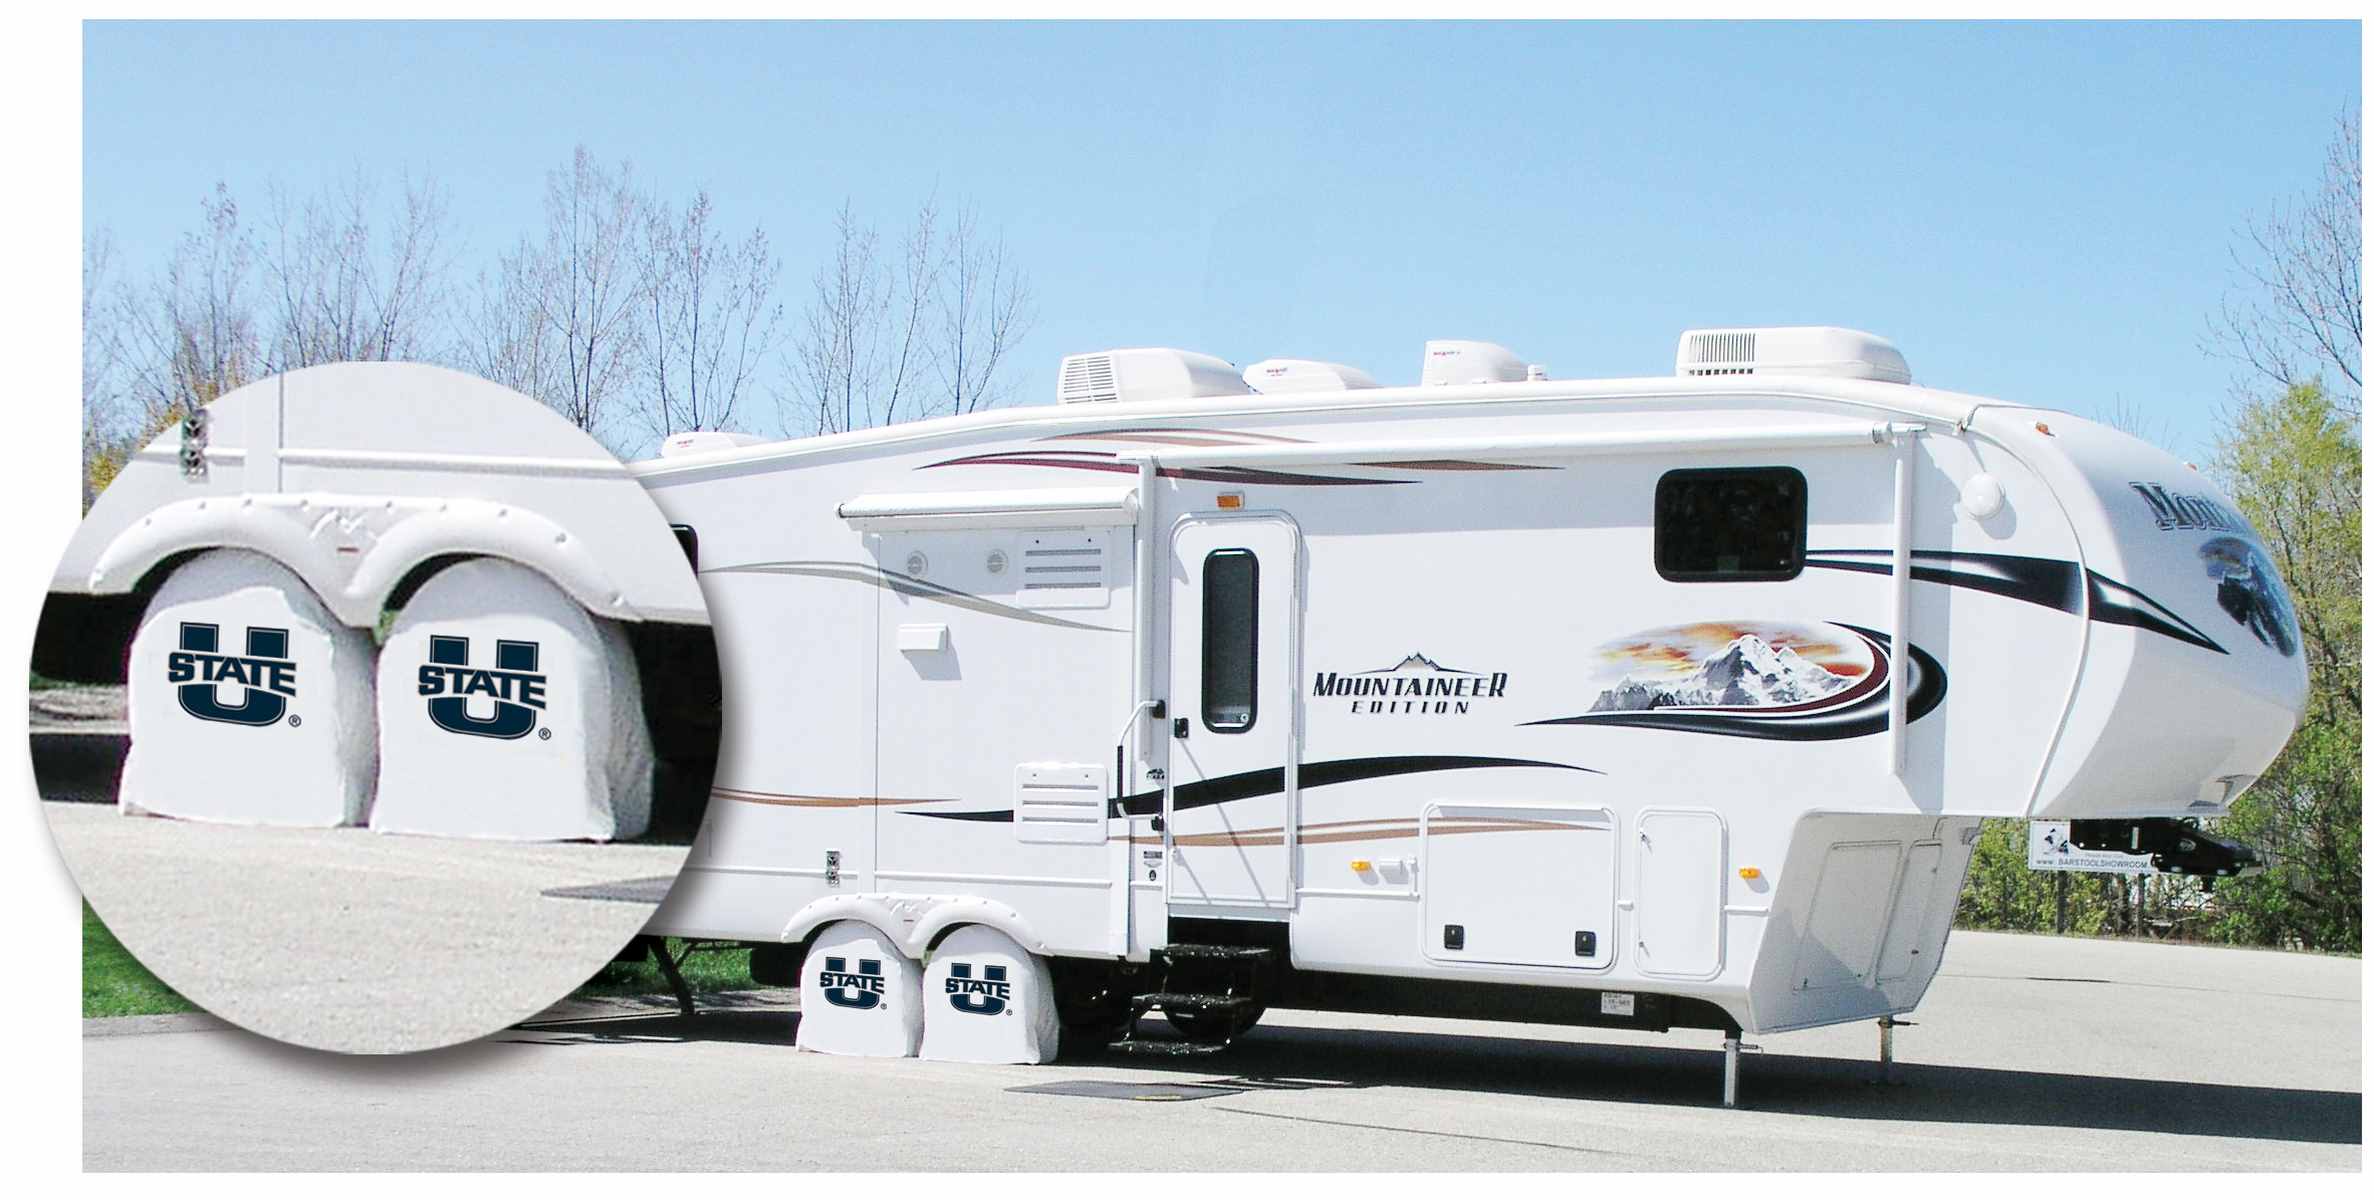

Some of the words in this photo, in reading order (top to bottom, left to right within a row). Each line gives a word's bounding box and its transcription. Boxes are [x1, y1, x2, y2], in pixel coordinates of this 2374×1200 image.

[168, 651, 297, 697] STATE
[1313, 672, 1508, 697] MOUNTAINEER
[418, 664, 547, 710] STATE
[1351, 700, 1470, 714] EDITION
[820, 971, 885, 995] STATE
[945, 977, 1010, 1001] STATE
